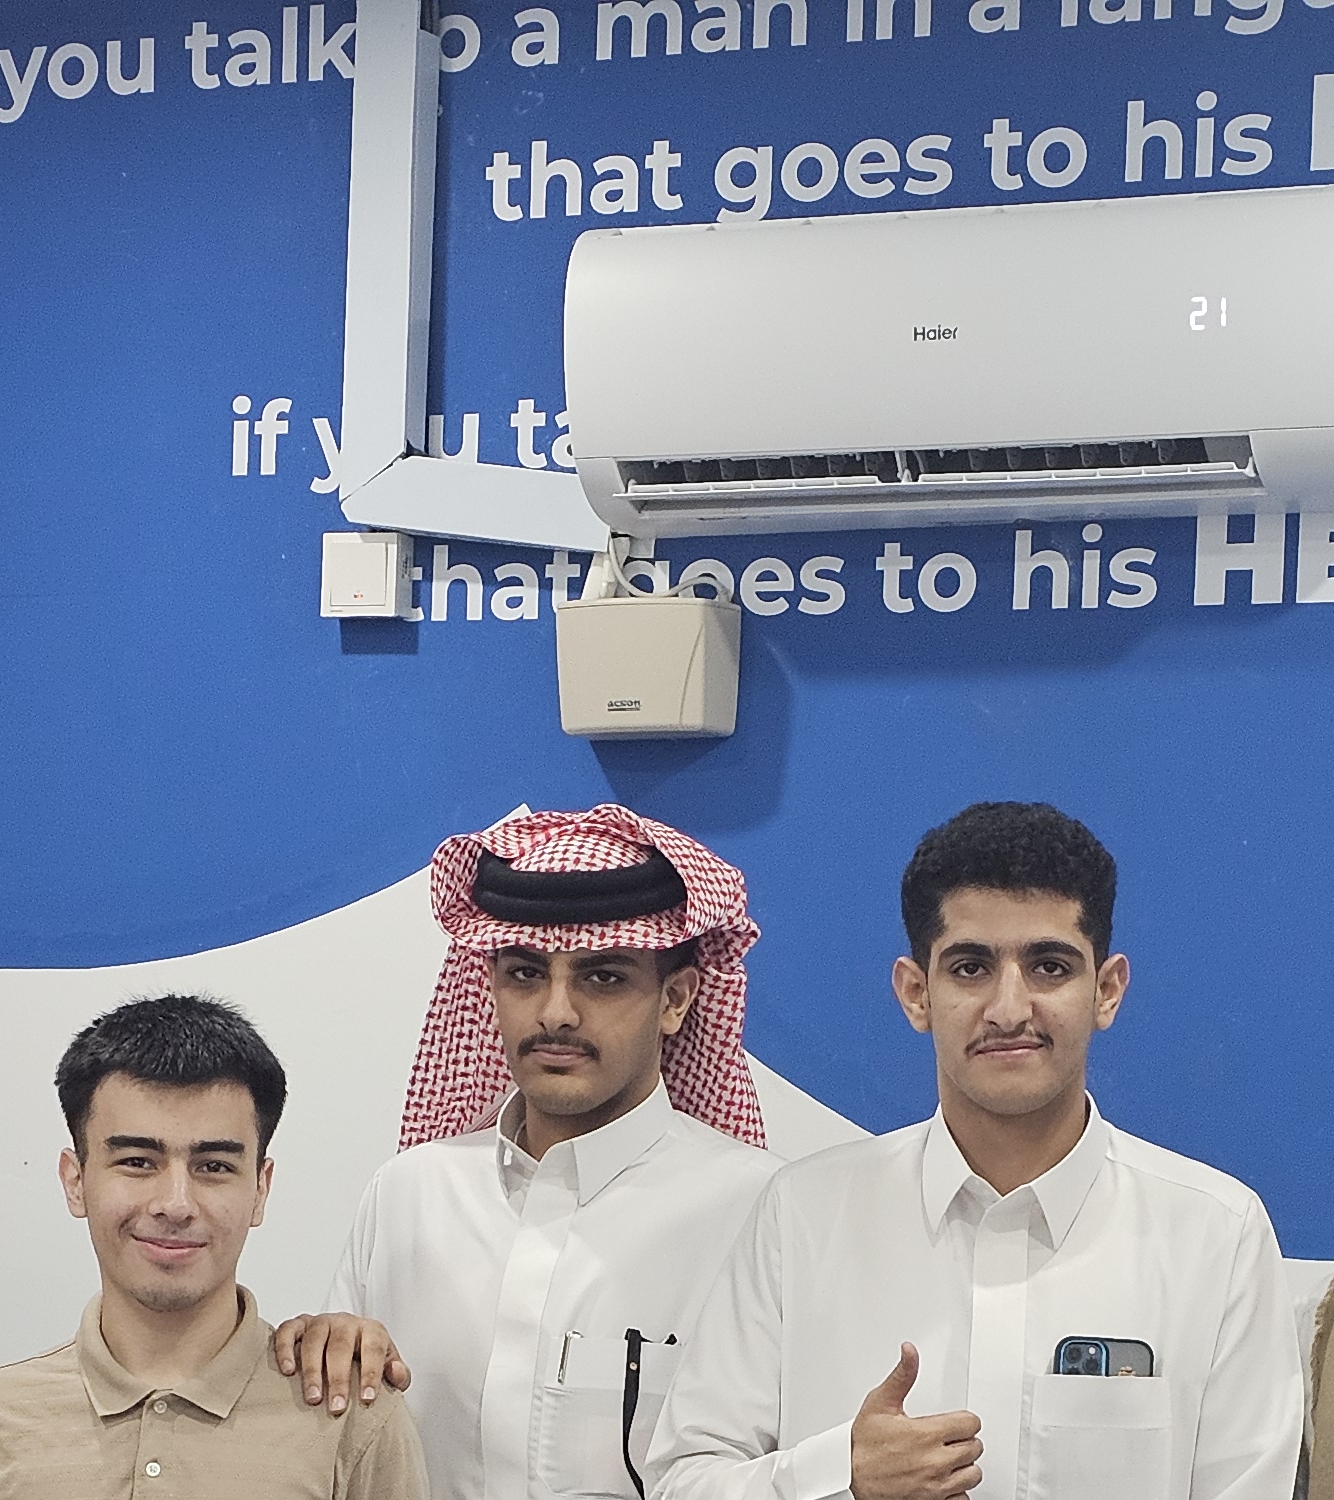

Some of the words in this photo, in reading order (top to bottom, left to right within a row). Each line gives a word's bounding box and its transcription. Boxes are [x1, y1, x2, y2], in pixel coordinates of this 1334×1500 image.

[185, 4, 356, 90] talk
[439, 14, 481, 73] o
[511, 7, 560, 67] a
[595, 0, 808, 60] man
[485, 139, 683, 221] that
[713, 131, 954, 223] goes
[984, 117, 1088, 192] to
[1123, 90, 1272, 183] his
[913, 325, 959, 342] Haier
[1189, 296, 1227, 331] 21
[230, 395, 292, 477] if
[309, 412, 480, 494] yu
[510, 399, 578, 470] ta
[875, 541, 977, 613] to
[1013, 522, 1158, 610] his
